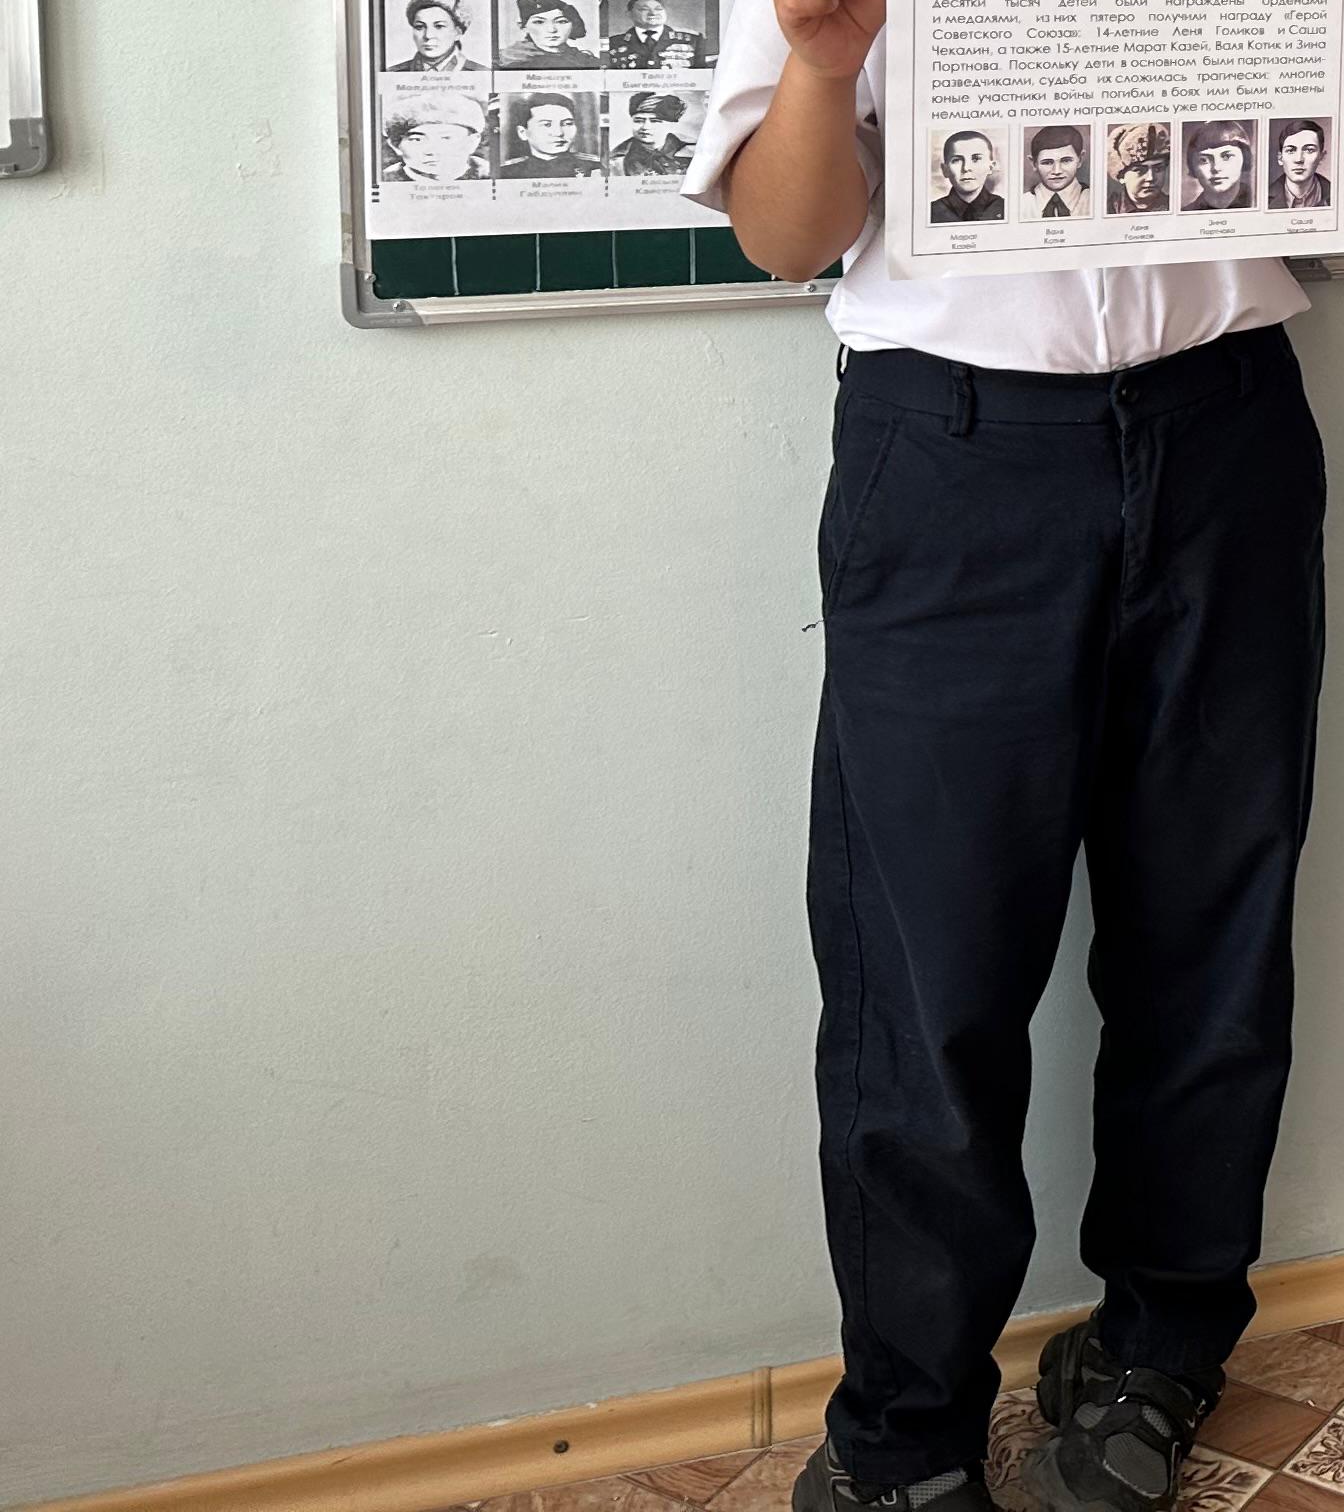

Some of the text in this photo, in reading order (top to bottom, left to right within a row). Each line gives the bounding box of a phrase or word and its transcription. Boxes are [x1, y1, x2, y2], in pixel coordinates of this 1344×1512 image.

[1005, 0, 1041, 8] тысяч
[945, 15, 1021, 25] медалями,
[1036, 14, 1050, 23] из
[1053, 14, 1077, 23] них
[1090, 13, 1135, 25] пятеро
[1148, 12, 1206, 23] получили
[1220, 11, 1272, 22] награду
[932, 28, 1013, 40] Советского
[1096, 26, 1159, 37] 14-летние
[1172, 26, 1203, 36] Леня
[1215, 25, 1264, 36] Голиков
[1288, 24, 1327, 35] Саша
